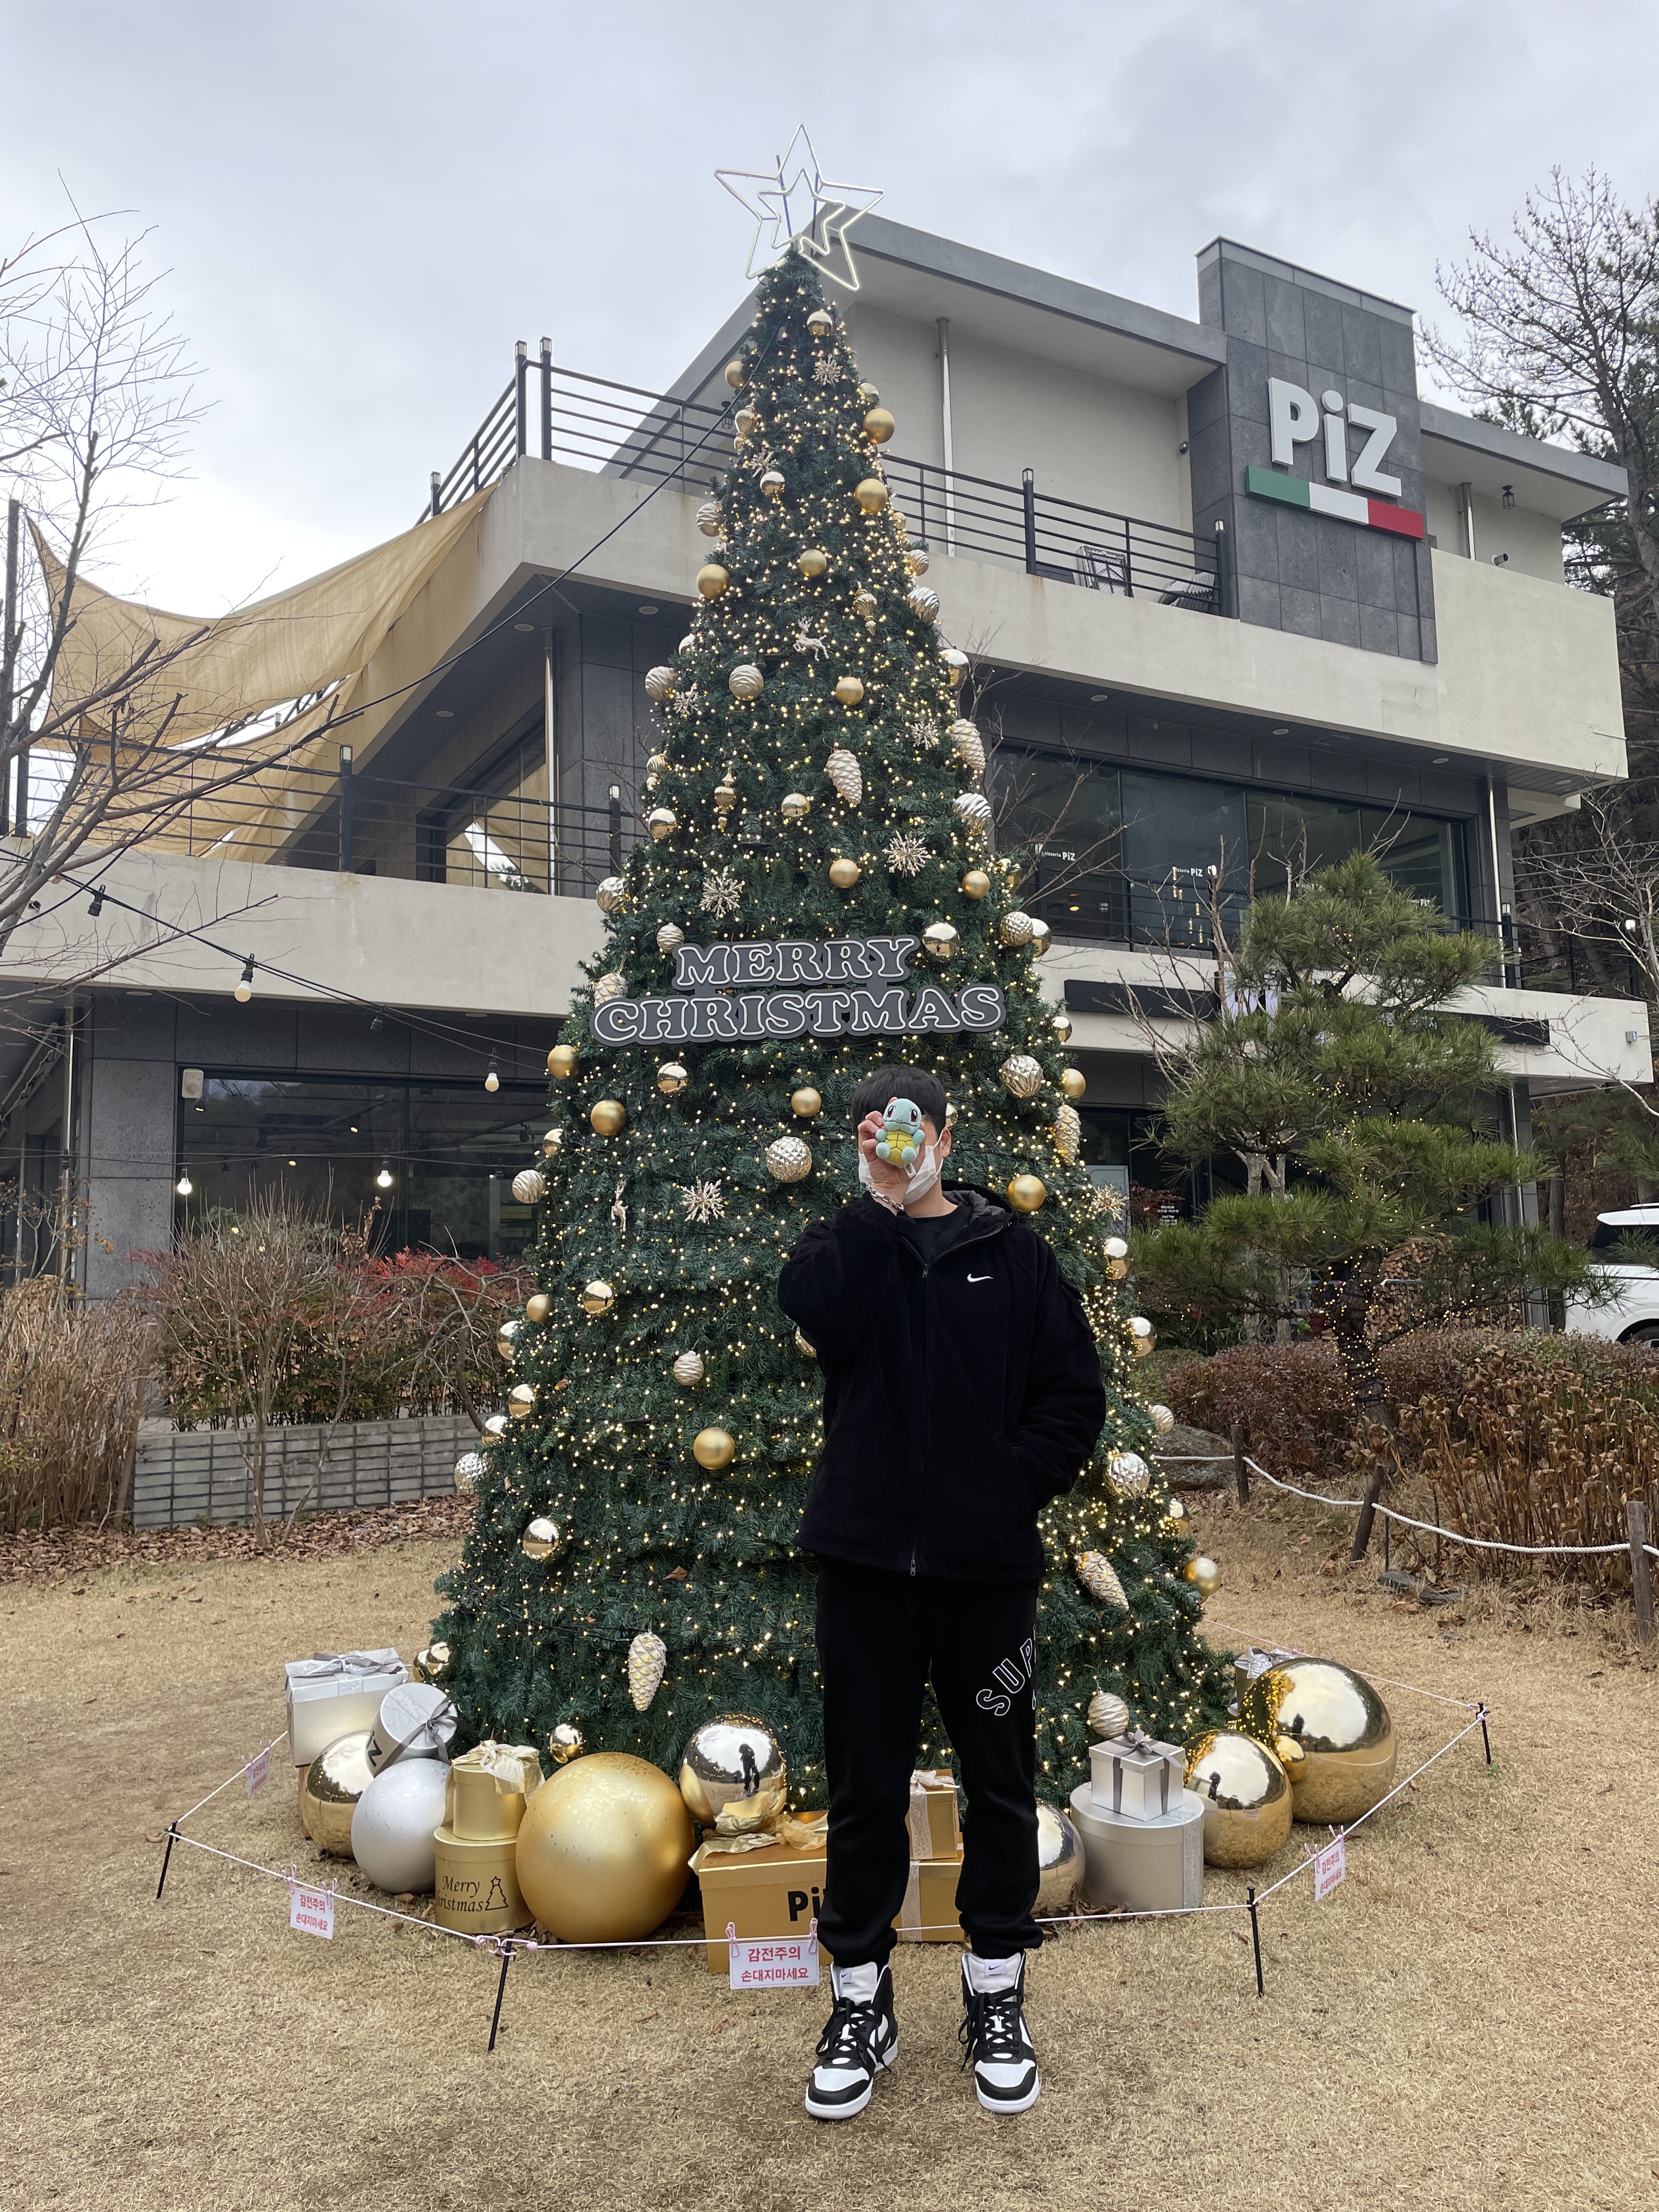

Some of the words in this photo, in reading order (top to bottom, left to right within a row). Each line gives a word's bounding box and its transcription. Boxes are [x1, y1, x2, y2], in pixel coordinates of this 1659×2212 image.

[1268, 377, 1402, 498] PiZ
[1062, 851, 1076, 861] PiZ
[1190, 867, 1203, 877] PiZ
[676, 939, 916, 986] MERRY
[593, 986, 1003, 1041] CHRISTMAS
[976, 1625, 1036, 1716] SUP
[1321, 1849, 1340, 1875] 감전주의
[442, 1875, 480, 1898] Merry
[1320, 1867, 1342, 1894] 손대지마세요
[300, 1894, 325, 1913] 감전주의
[787, 1887, 827, 1922] Pi
[296, 1912, 328, 1931] 손대지마세요
[748, 1945, 801, 1963] 감전주의
[741, 1967, 809, 1982] 손대지마세요
